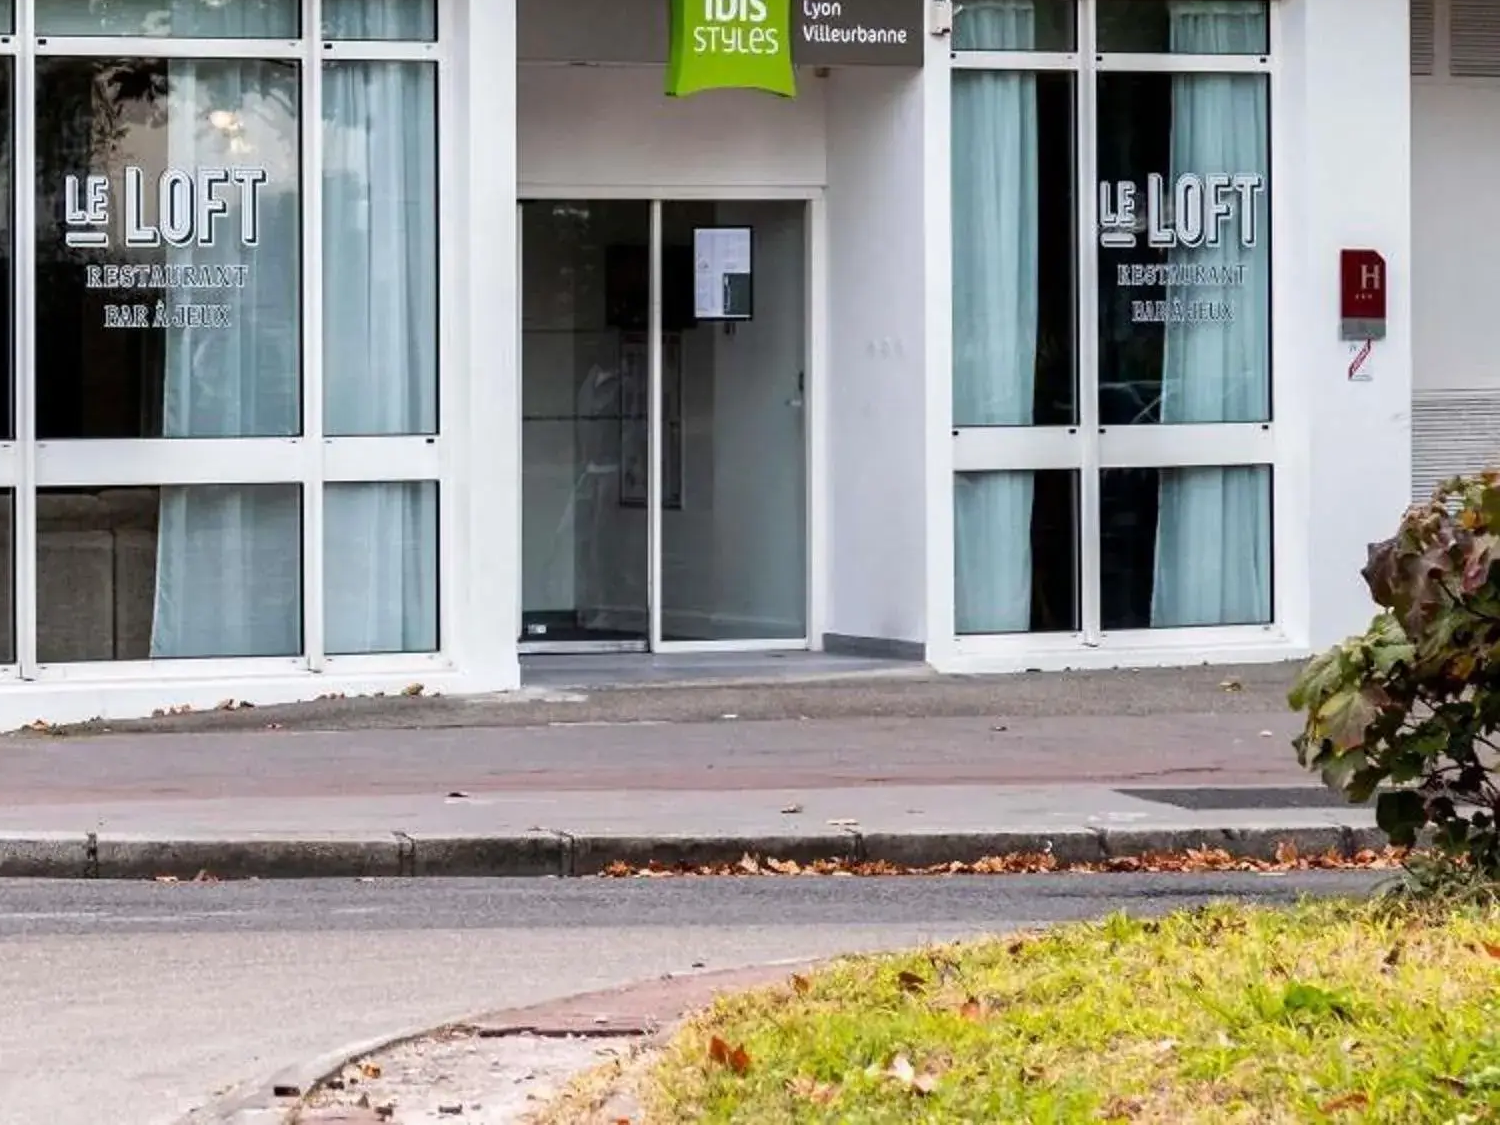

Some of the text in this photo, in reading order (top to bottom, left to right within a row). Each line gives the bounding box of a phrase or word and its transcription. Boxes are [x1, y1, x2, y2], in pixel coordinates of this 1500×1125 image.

[803, 0, 842, 17] Lyon
[803, 25, 908, 44] Villeurbanne
[65, 166, 269, 247] LE LOFT
[1100, 173, 1264, 248] LE LOFT
[86, 264, 249, 288] RESTAURANT
[1117, 264, 1248, 287] RESTAURANT
[1361, 264, 1380, 290] H
[103, 304, 149, 328] BAR
